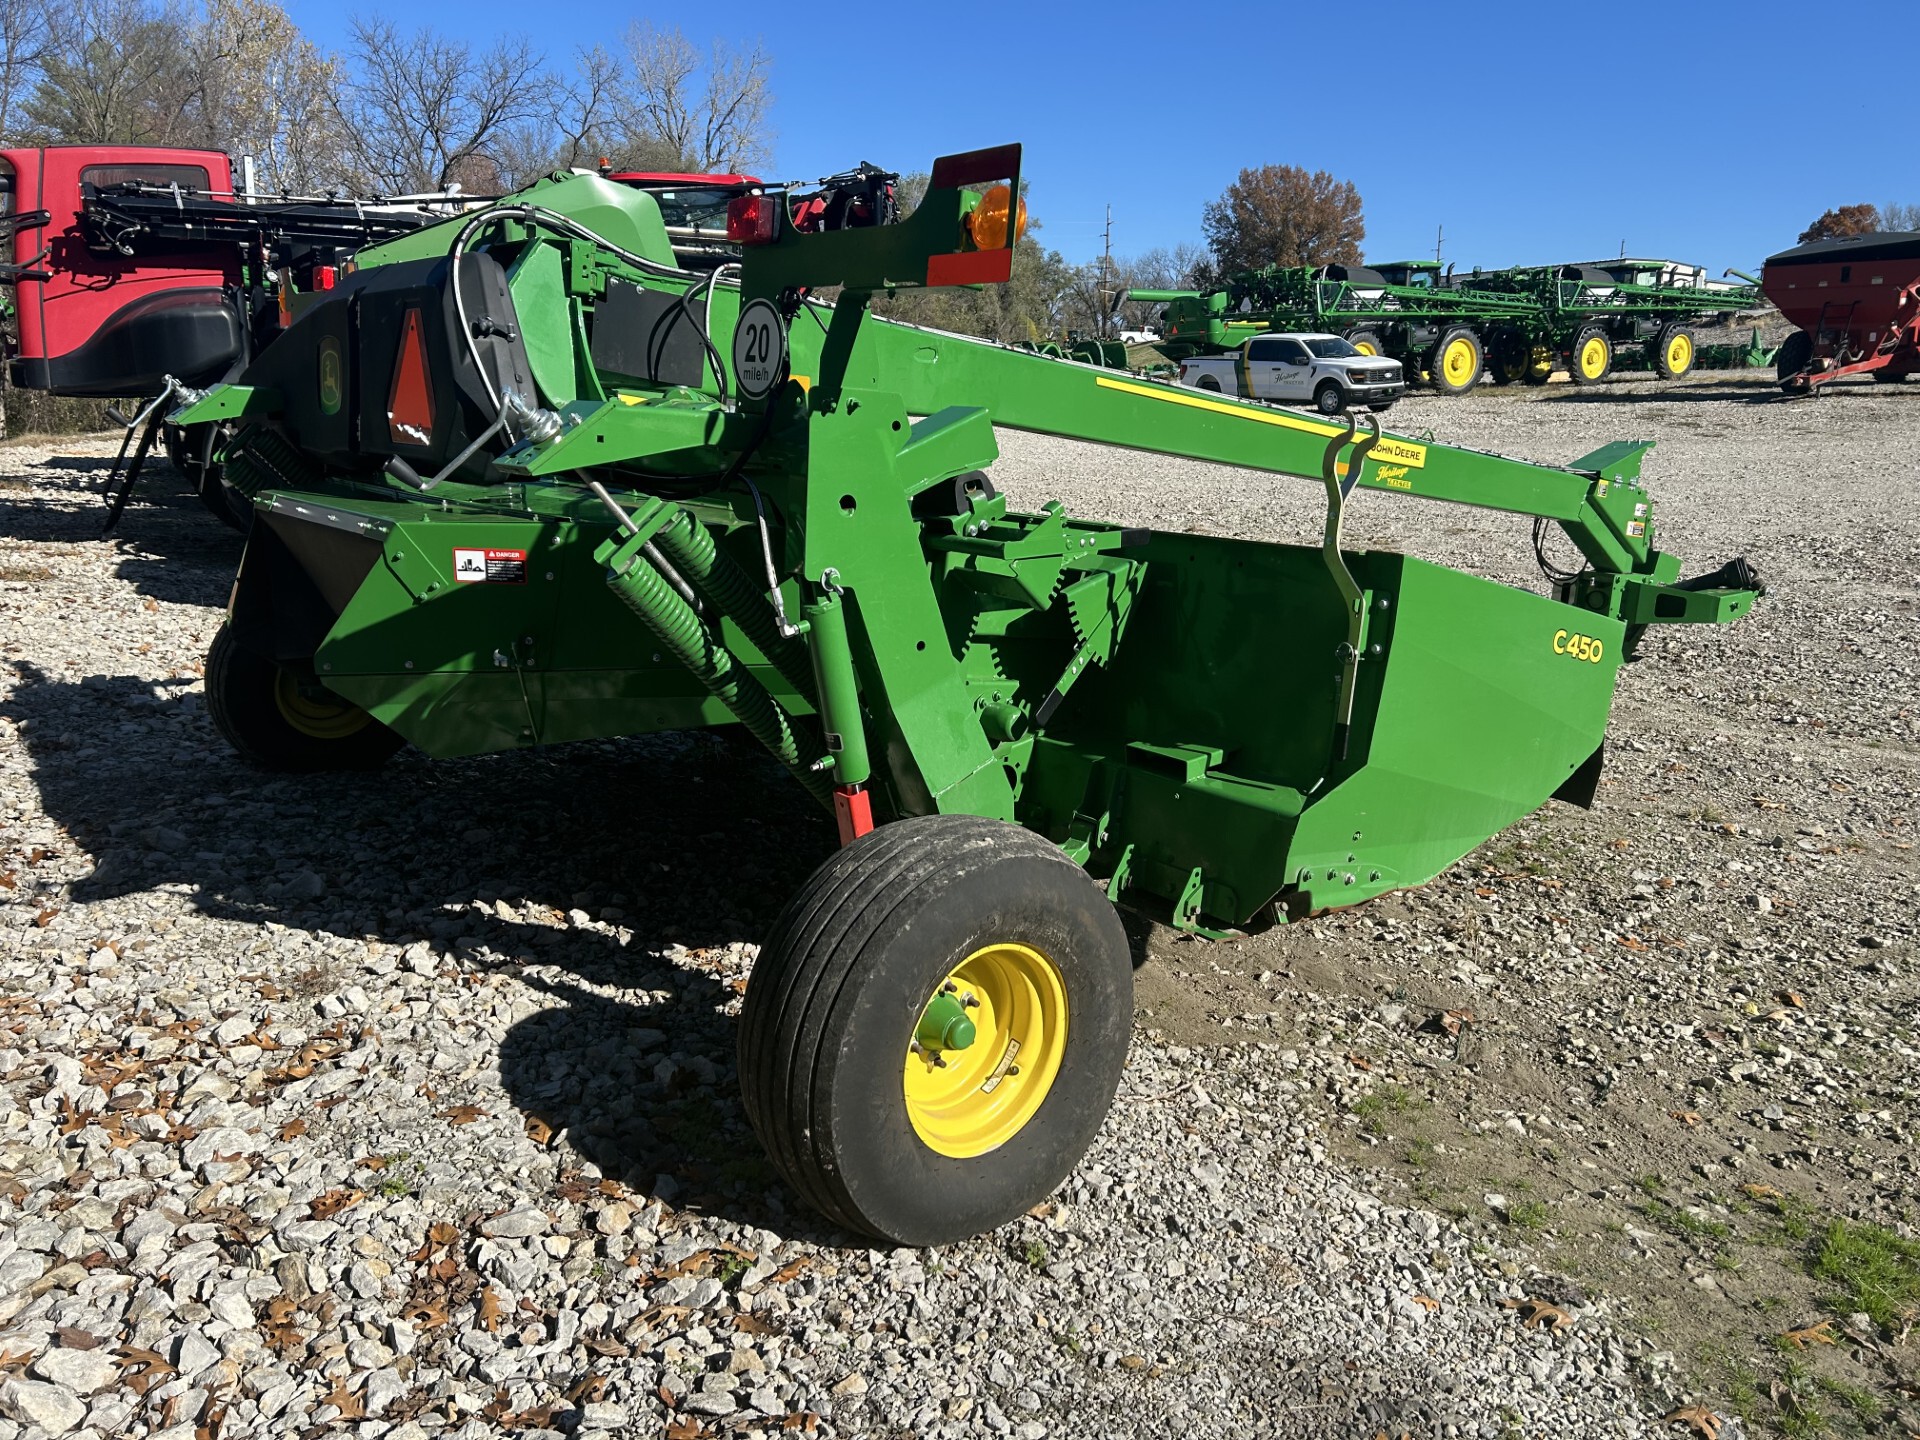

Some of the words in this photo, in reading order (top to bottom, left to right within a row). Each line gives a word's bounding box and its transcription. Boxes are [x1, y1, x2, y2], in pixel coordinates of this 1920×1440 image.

[744, 323, 770, 363] 20
[743, 367, 769, 381] mile/h
[1394, 446, 1421, 460] DEERE
